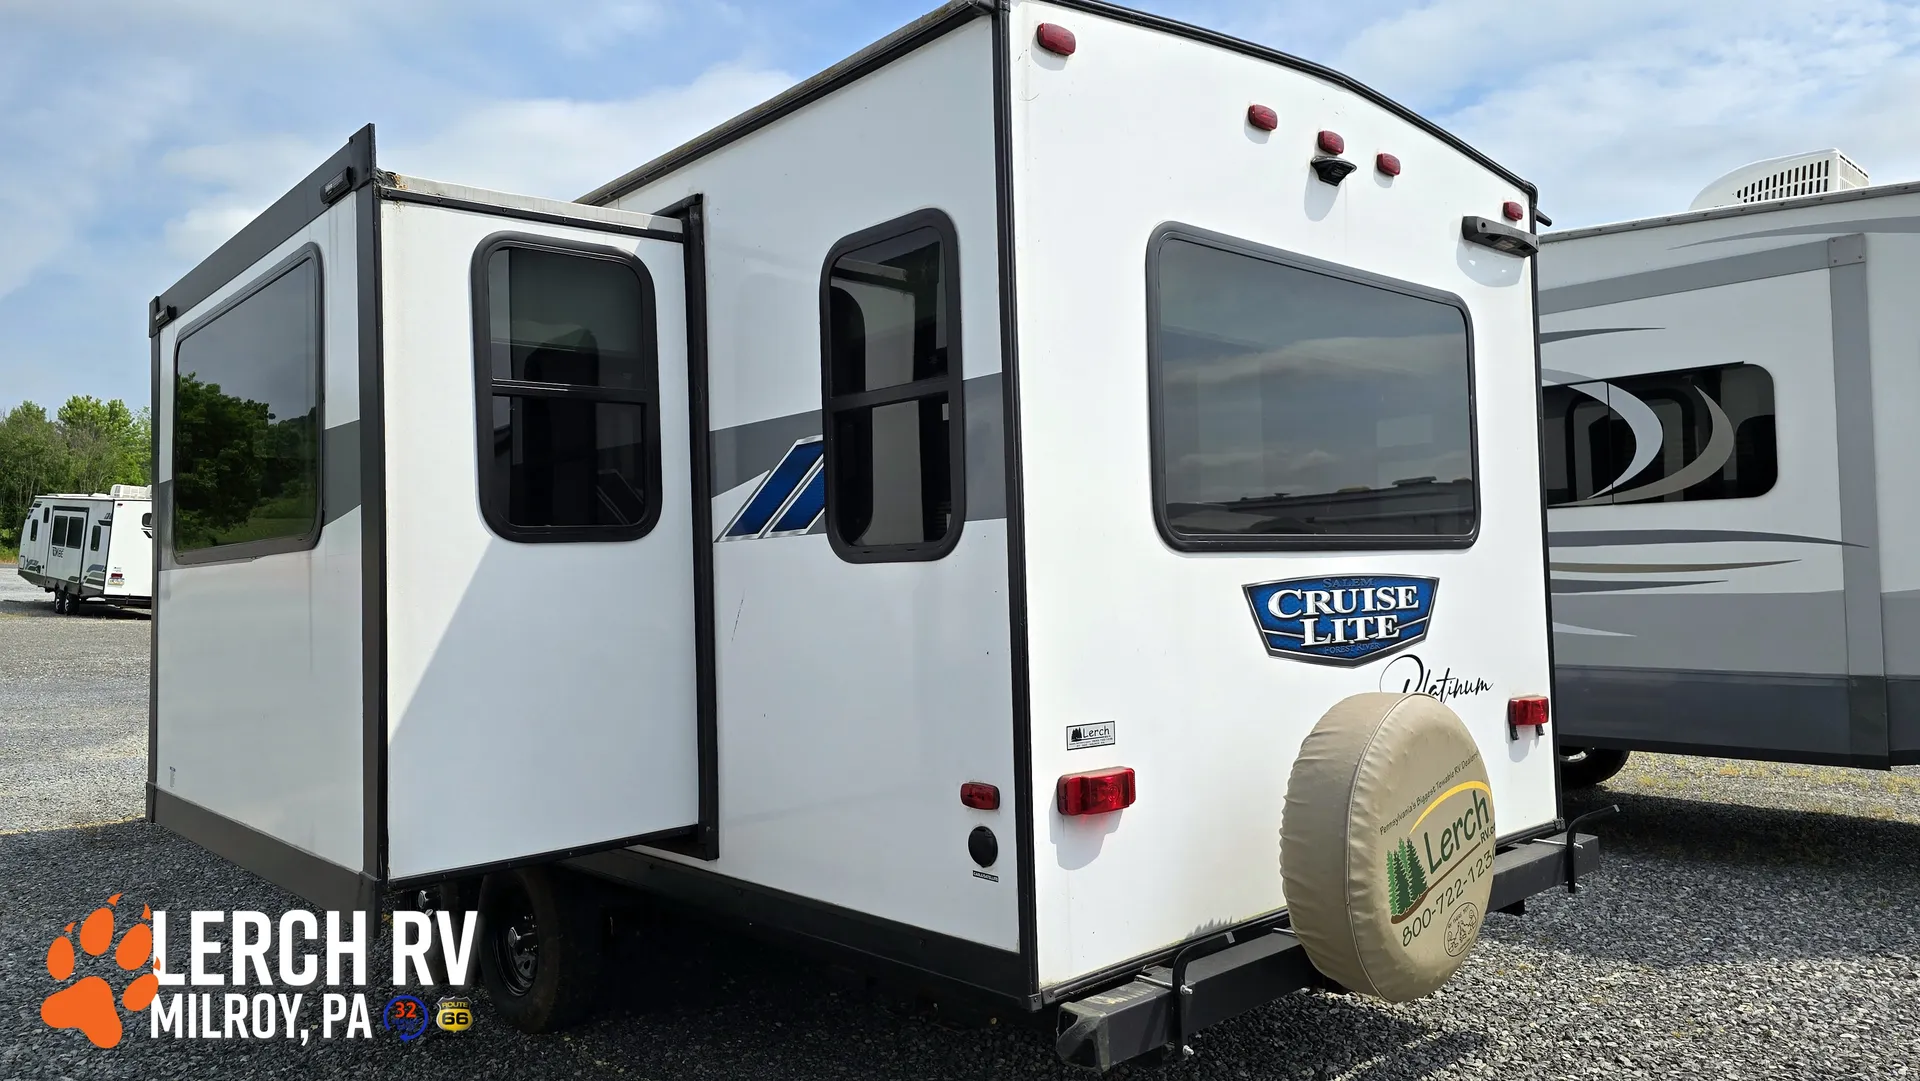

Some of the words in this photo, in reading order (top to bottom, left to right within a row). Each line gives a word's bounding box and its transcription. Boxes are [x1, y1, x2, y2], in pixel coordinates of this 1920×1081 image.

[1322, 578, 1375, 588] SALEM
[1267, 585, 1419, 619] CRUISE
[1299, 615, 1400, 647] LITE
[1324, 645, 1356, 655] FOREST
[1356, 642, 1381, 651] RIVER
[1379, 654, 1494, 704] Platinum
[1082, 725, 1110, 739] Lerch
[1416, 786, 1436, 805] Biggest
[1453, 763, 1461, 775] RV
[1424, 790, 1489, 874] Lerch
